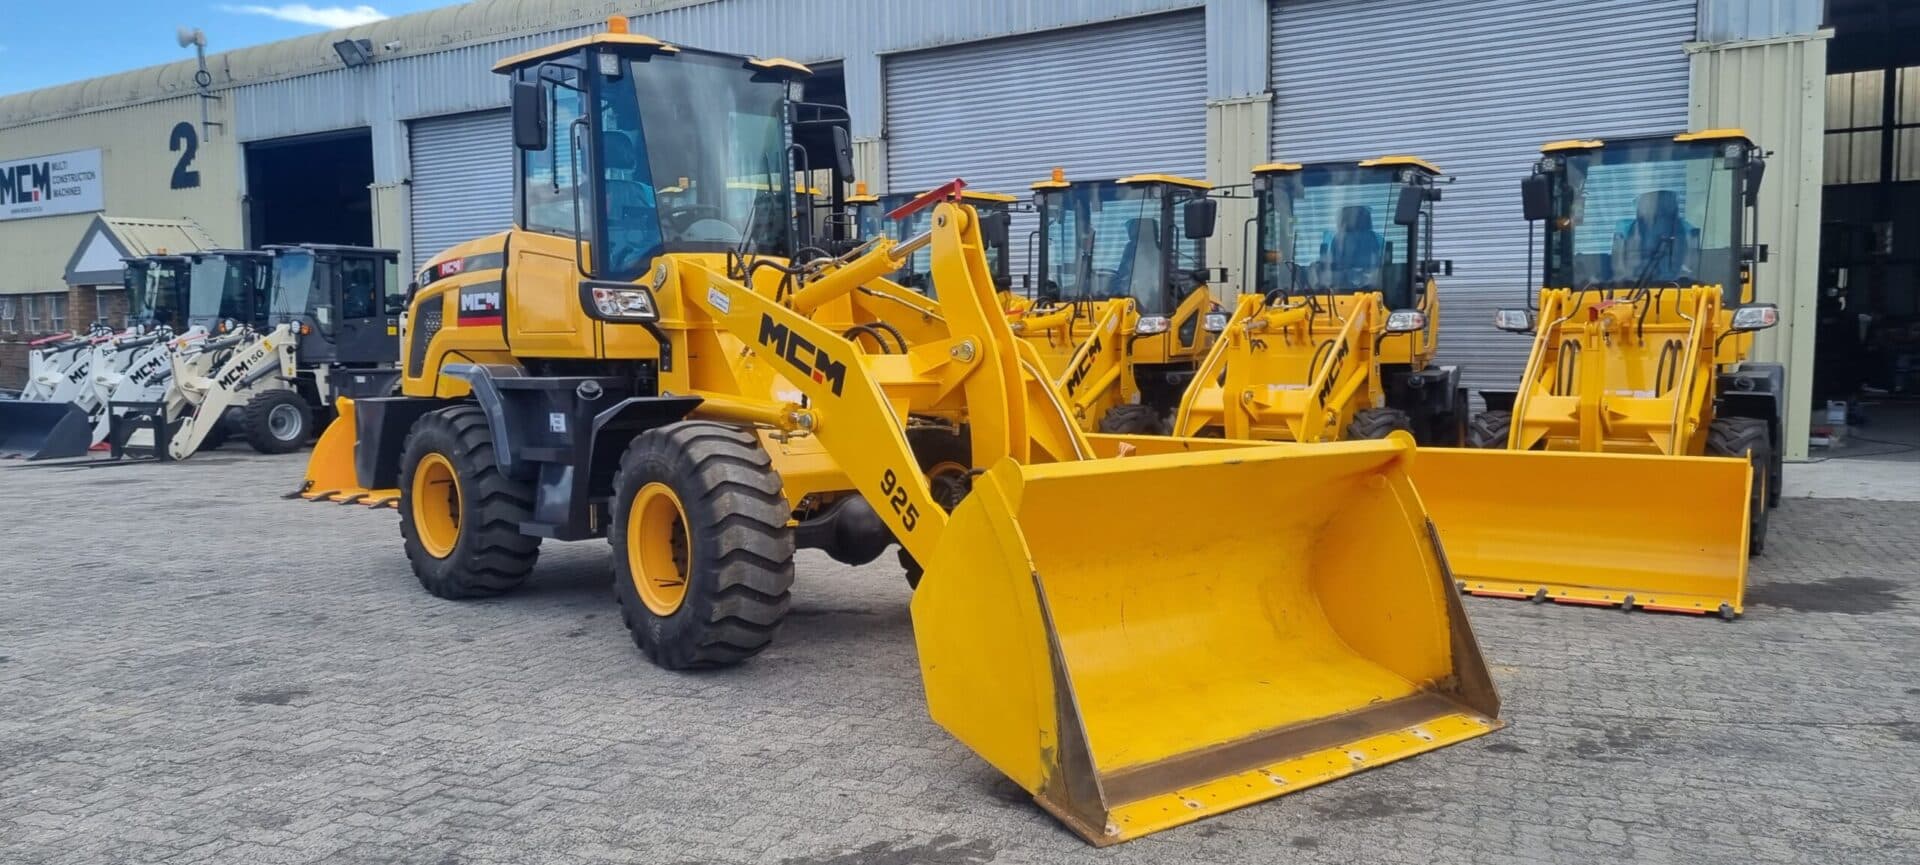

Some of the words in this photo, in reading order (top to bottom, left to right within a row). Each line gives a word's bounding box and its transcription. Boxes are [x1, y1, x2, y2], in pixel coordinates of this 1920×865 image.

[169, 121, 200, 190] 2
[0, 161, 52, 205] MCM
[51, 171, 96, 184] CONSTRUCTION
[53, 186, 81, 197] MACHINES
[441, 259, 461, 276] MCM
[461, 292, 500, 311] MCM
[758, 312, 847, 397] MCM
[1067, 336, 1102, 398] MCM
[68, 361, 89, 384] MC
[130, 357, 162, 384] MCM
[218, 361, 249, 390] MCM
[1319, 338, 1349, 410] MCM
[880, 468, 921, 532] 925
